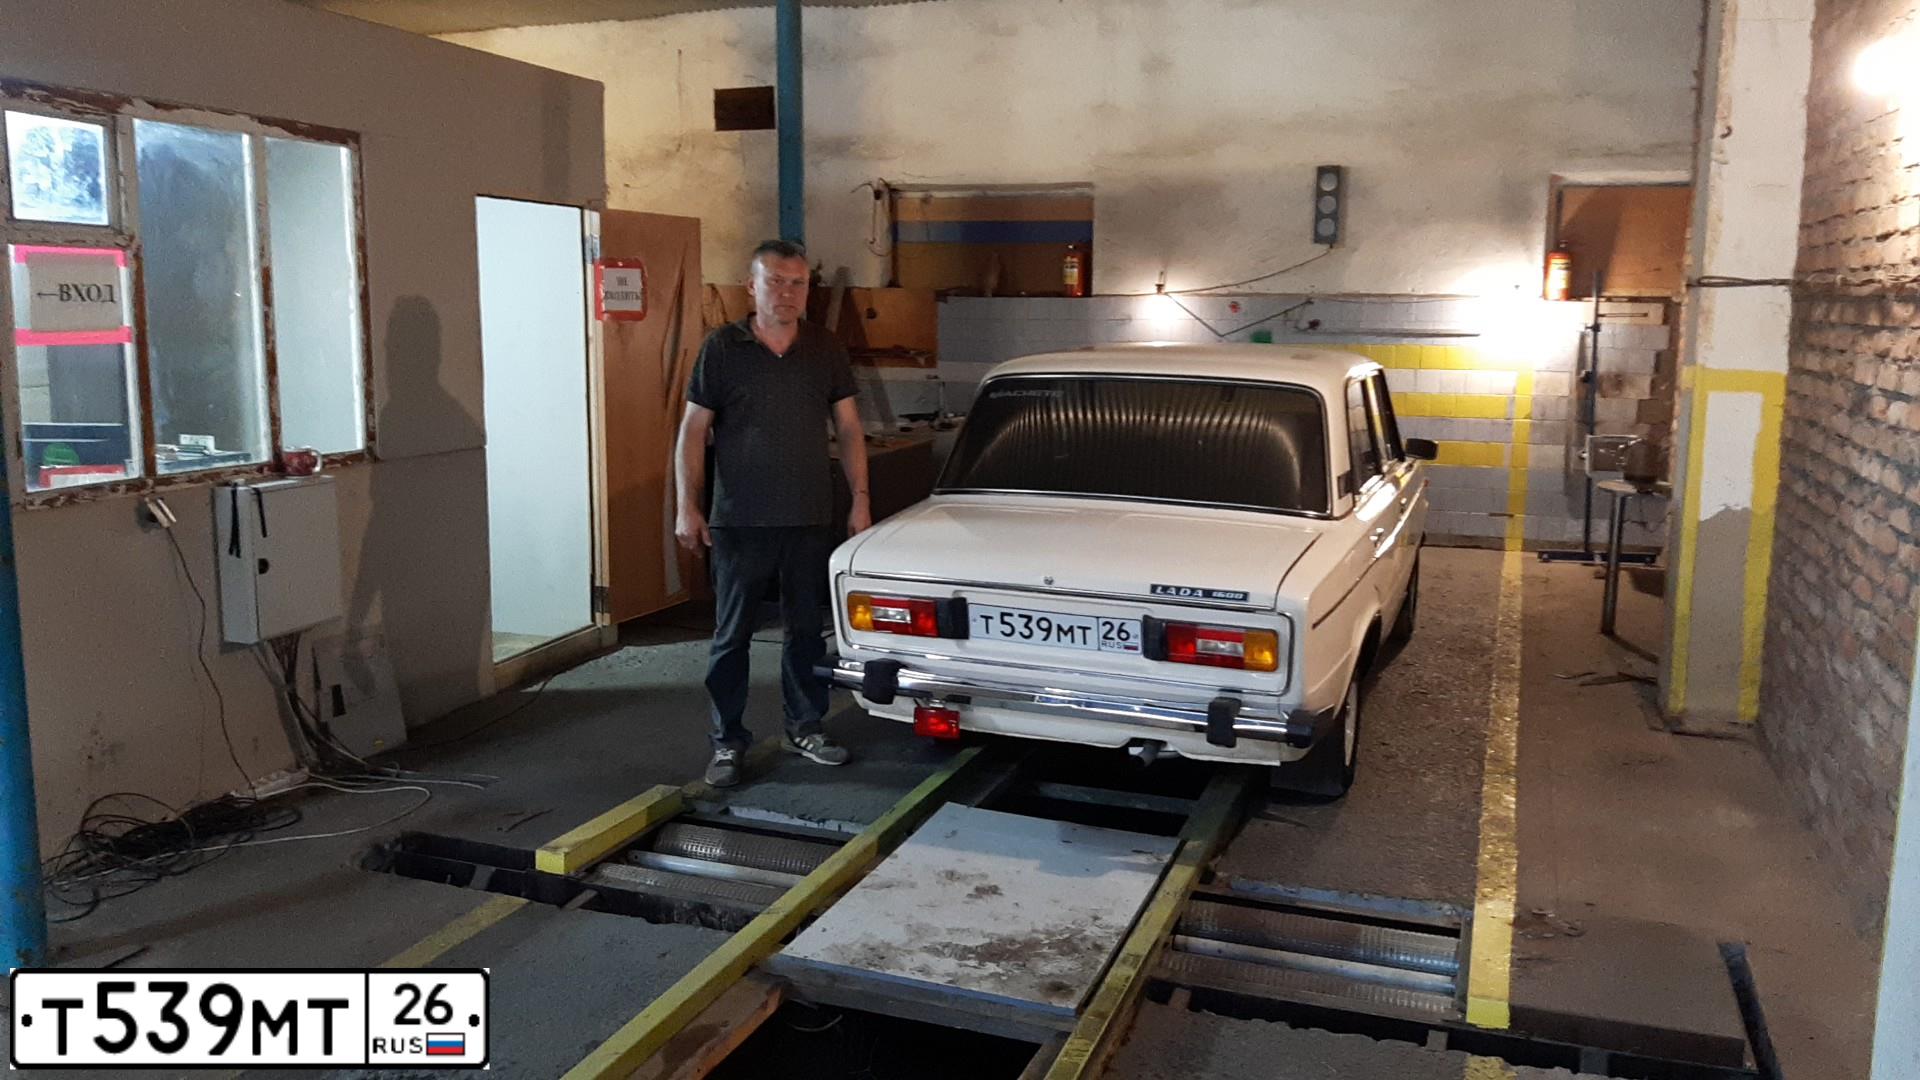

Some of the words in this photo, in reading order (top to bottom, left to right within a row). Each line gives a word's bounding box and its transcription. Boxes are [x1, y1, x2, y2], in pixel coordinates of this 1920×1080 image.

[58, 283, 116, 303] ВХОД
[1156, 586, 1203, 597] LADA
[1212, 591, 1244, 600] 1600
[1101, 620, 1131, 641] 26
[1101, 640, 1122, 649] RUS
